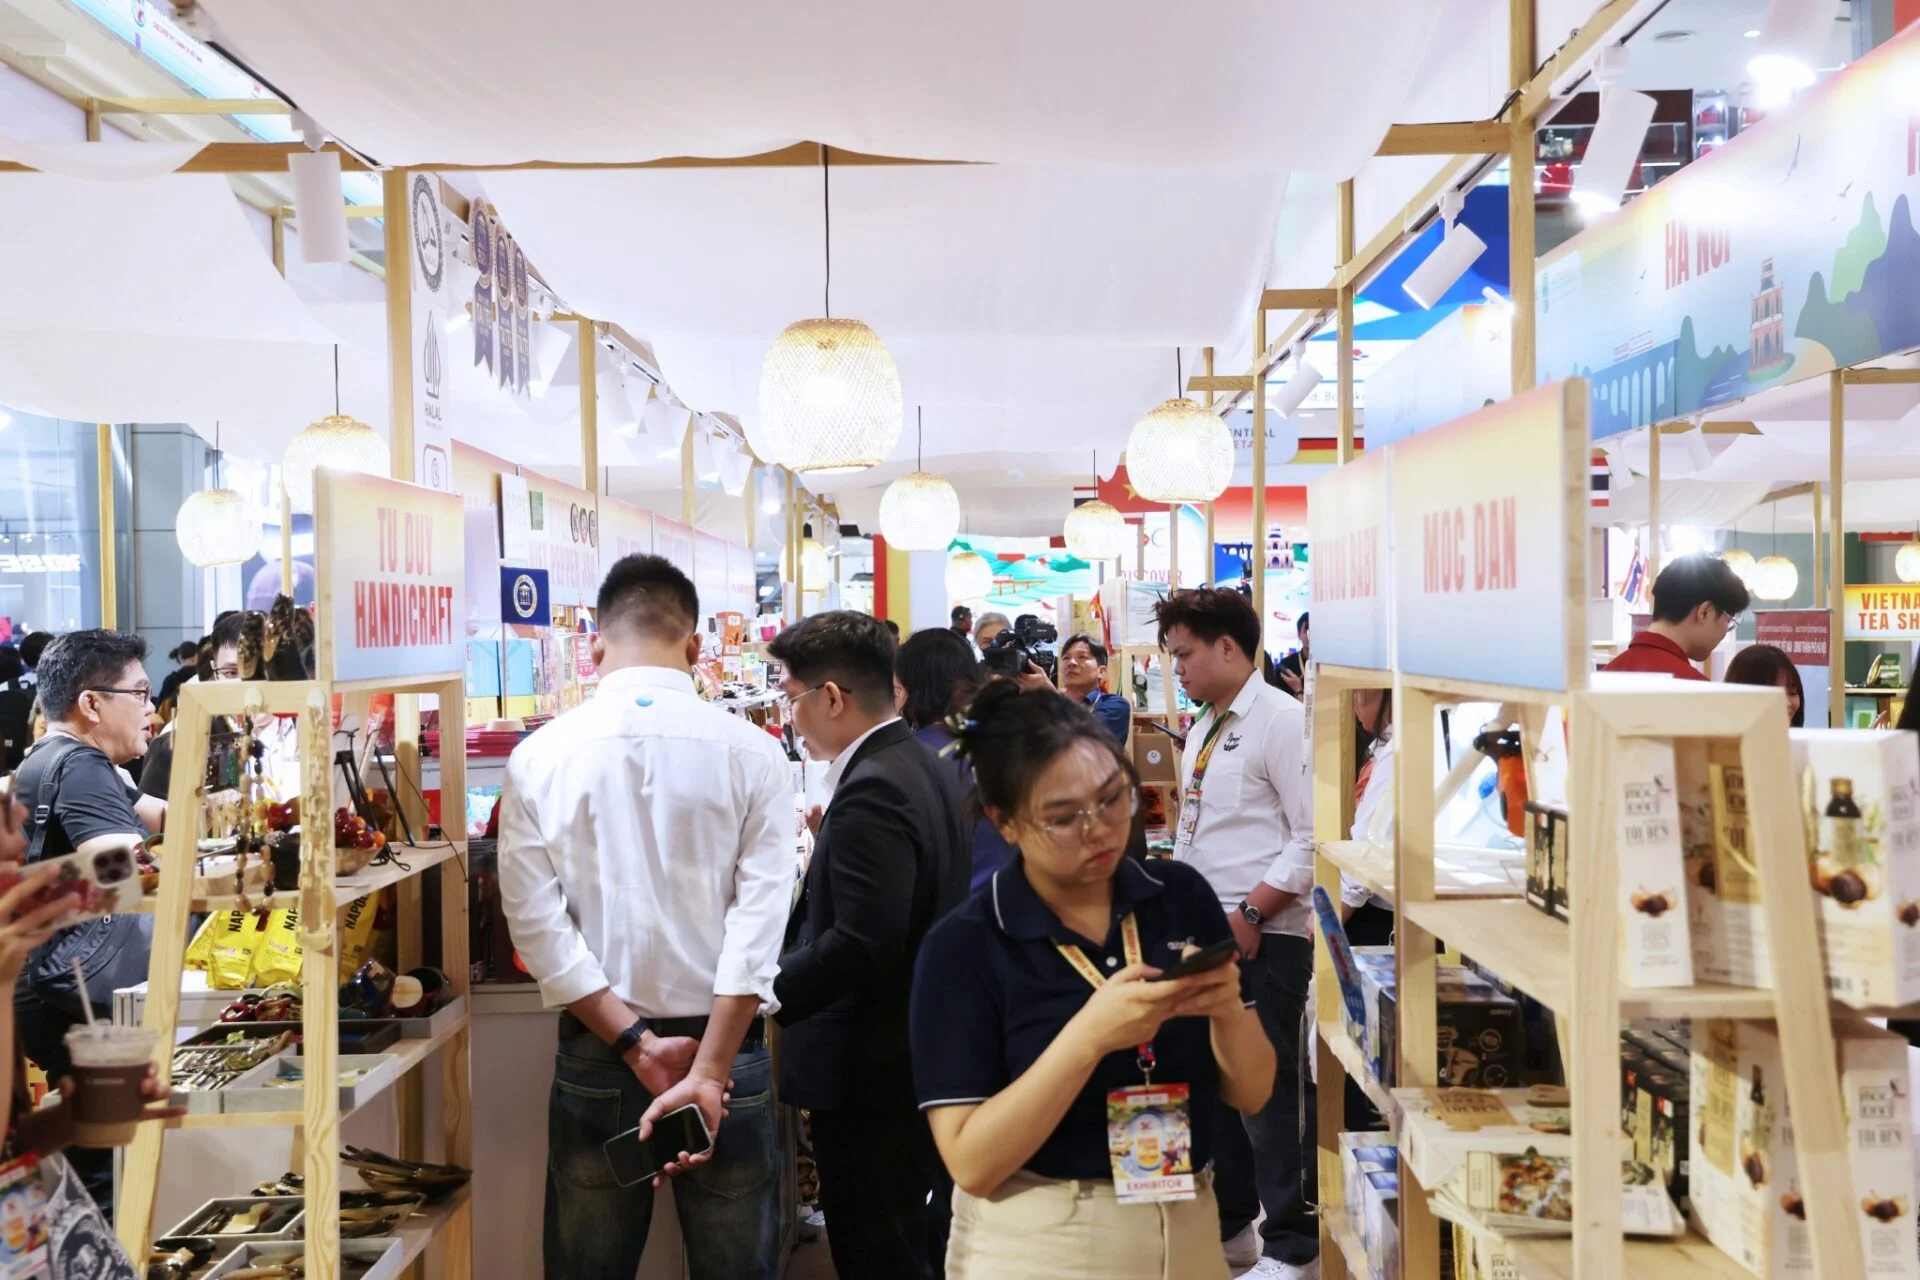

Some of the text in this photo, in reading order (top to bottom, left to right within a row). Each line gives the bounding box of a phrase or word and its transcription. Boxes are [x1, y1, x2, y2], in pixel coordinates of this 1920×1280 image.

[424, 401, 443, 422] HALAL
[376, 507, 398, 573] TU
[404, 510, 433, 577] DUY
[1423, 496, 1517, 594] MOC DAN
[353, 580, 453, 649] HANDICRAFT
[1858, 612, 1889, 631] TEA
[1125, 1178, 1183, 1192] EXHIBITOR
